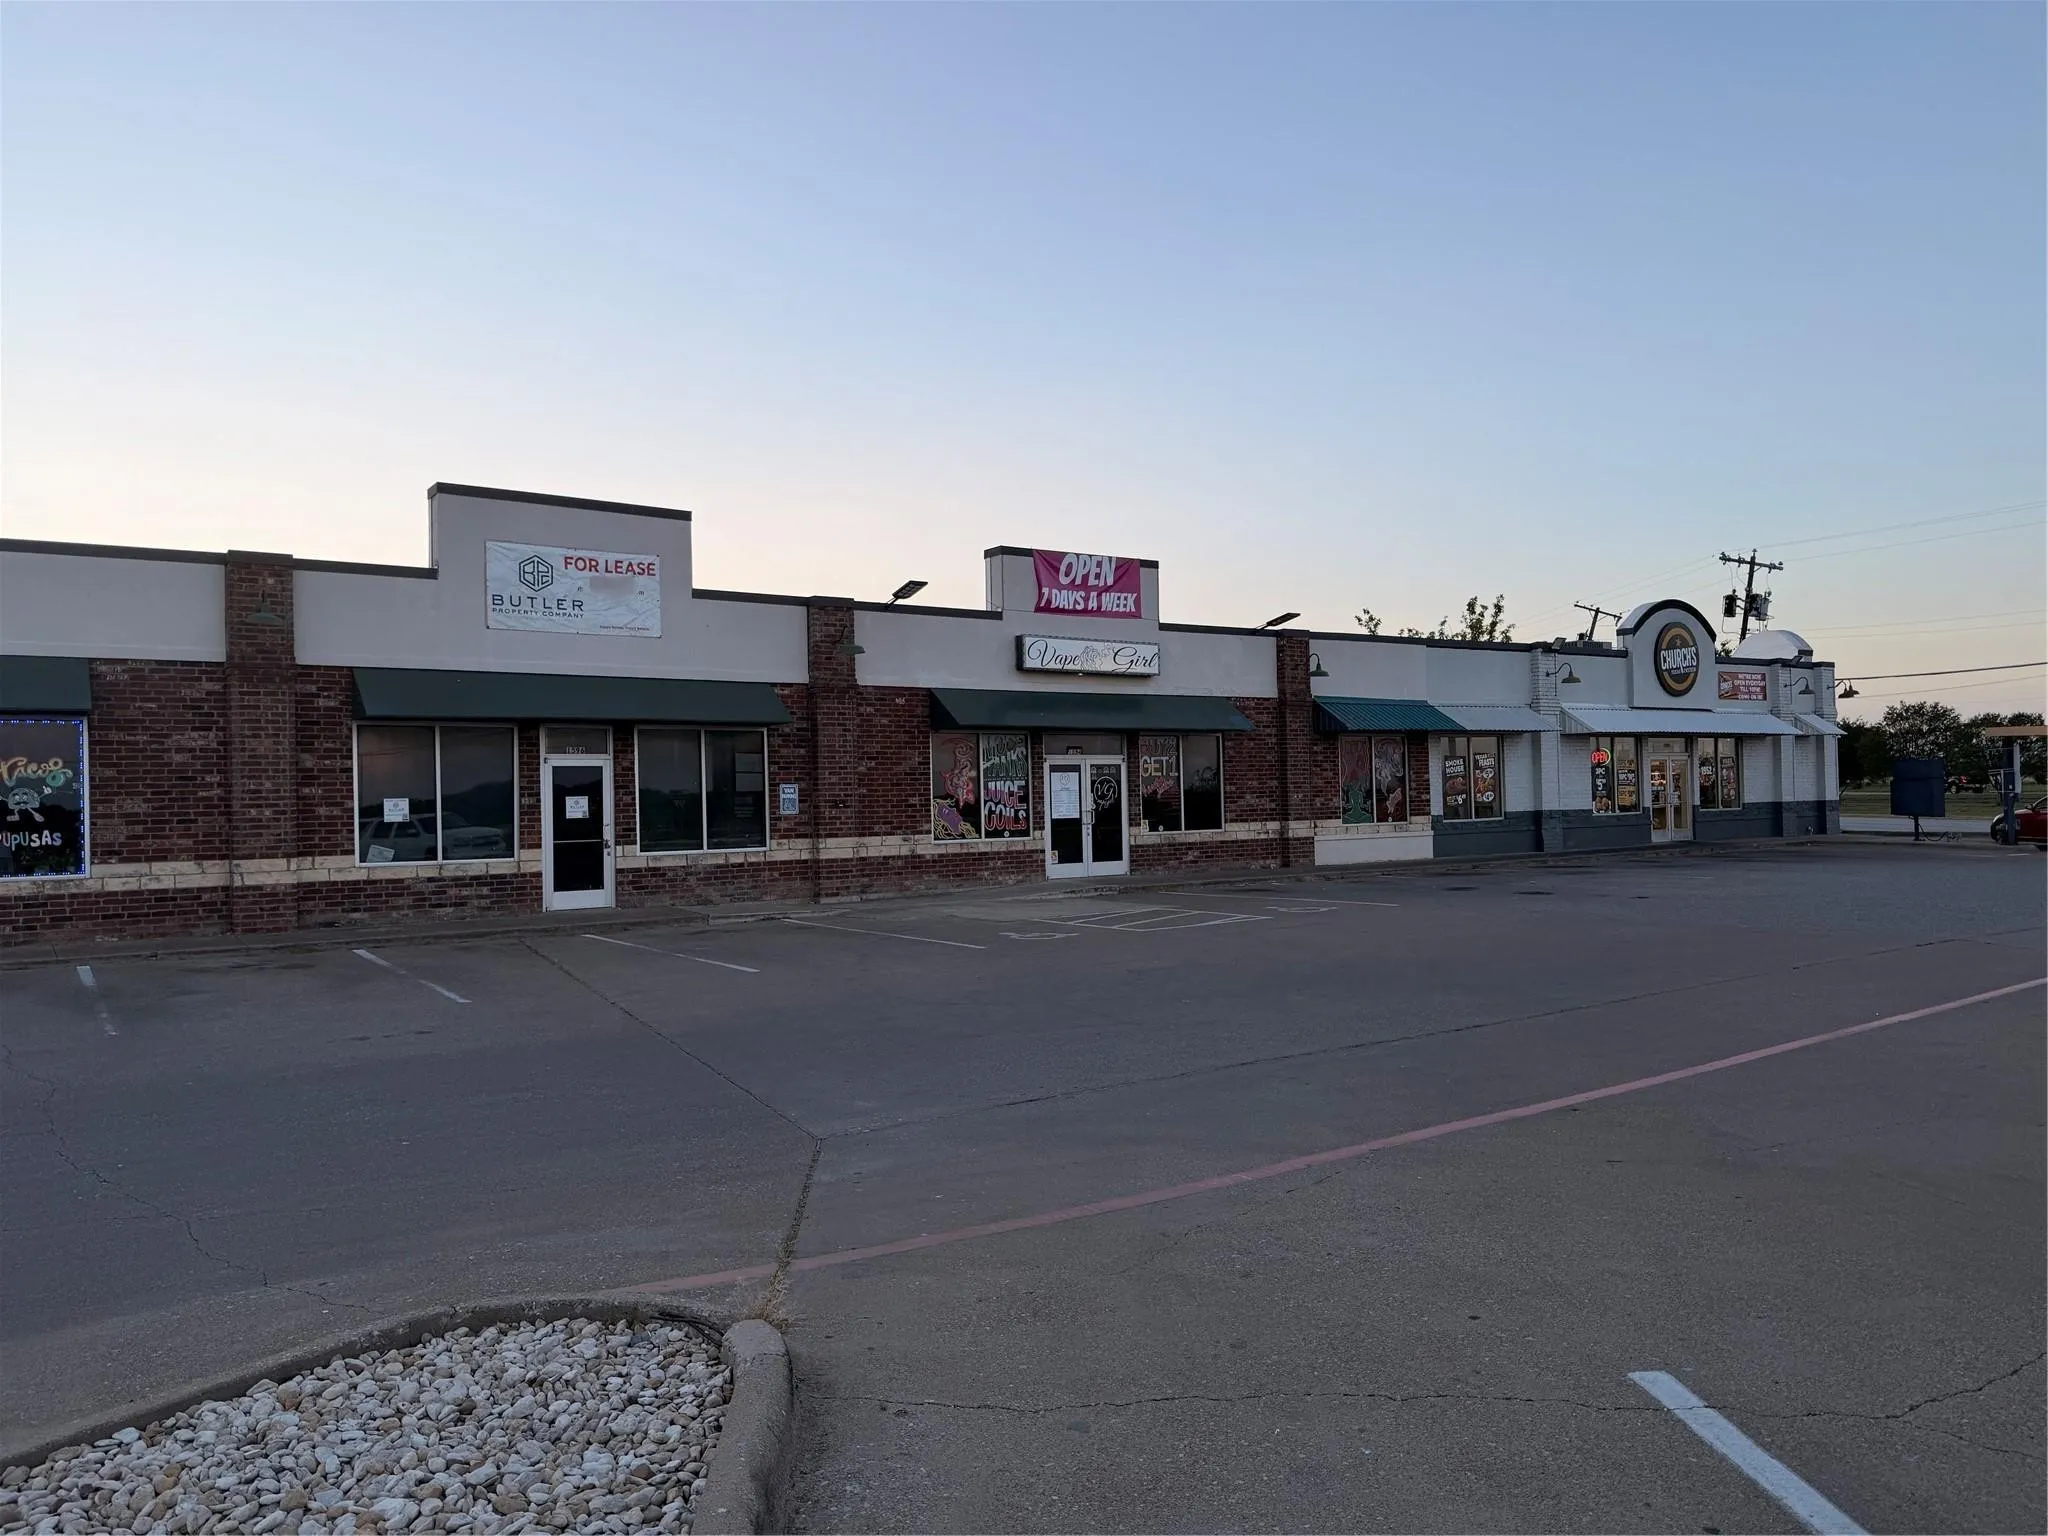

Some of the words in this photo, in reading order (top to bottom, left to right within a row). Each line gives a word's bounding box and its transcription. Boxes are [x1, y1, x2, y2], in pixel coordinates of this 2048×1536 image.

[564, 556, 599, 573] FOR
[604, 559, 656, 577] LEASE
[1059, 553, 1116, 587] OPEN
[492, 594, 584, 612] BUTLER
[1040, 587, 1049, 607] 7
[1051, 589, 1086, 610] DAYS
[1088, 591, 1098, 611] A
[1101, 592, 1138, 612] WEEK
[492, 608, 538, 616] PROPERTY
[542, 610, 584, 618] COMPANY
[1027, 639, 1081, 669] Vape
[1112, 646, 1160, 673] Girl
[1445, 758, 1464, 767] SMOKE
[1591, 751, 1608, 764] OPEN
[1446, 765, 1465, 774] HOUSE
[983, 780, 1027, 809] JUICE
[984, 802, 1027, 831] COILS
